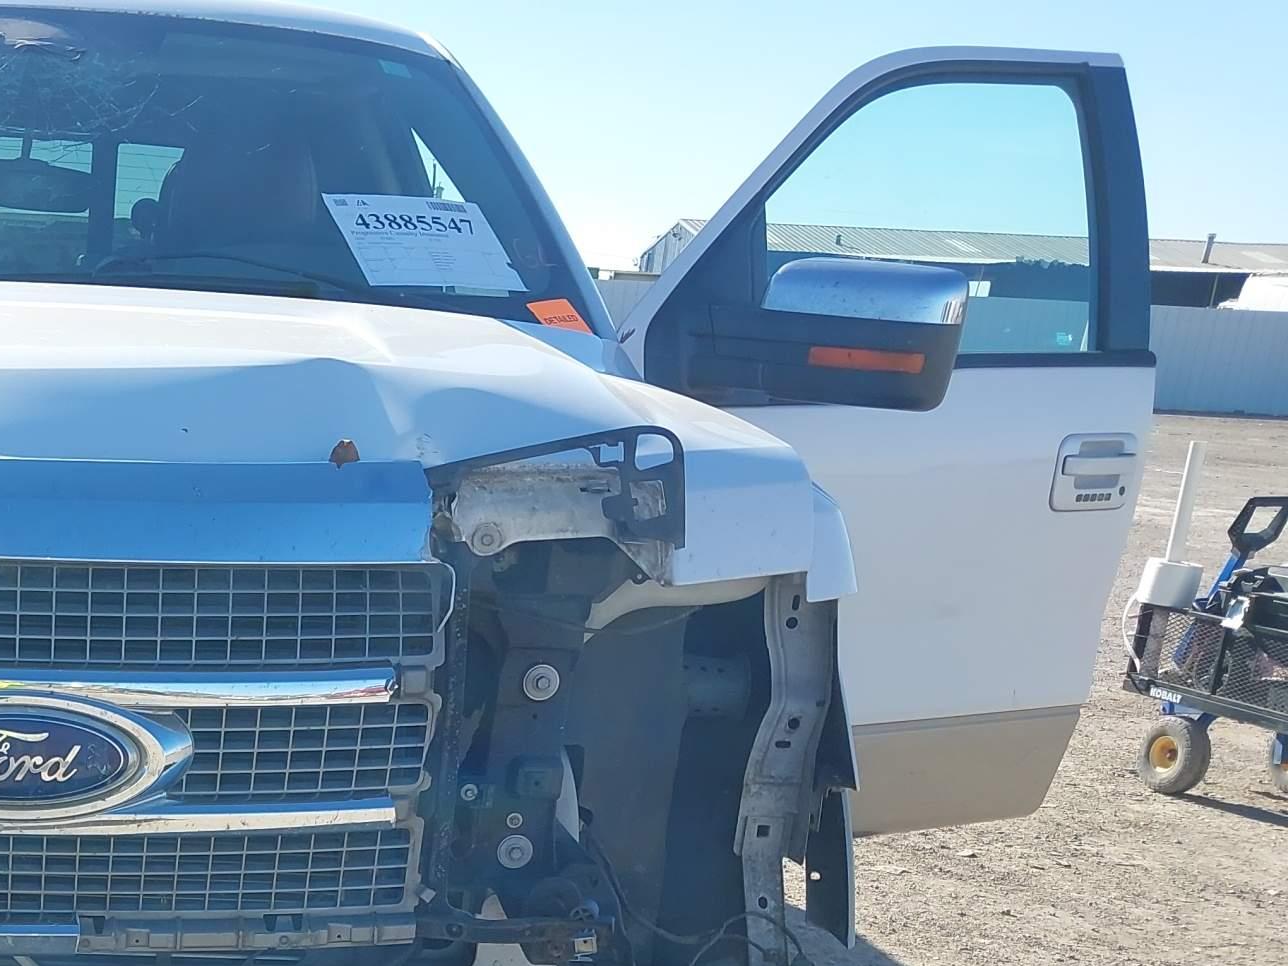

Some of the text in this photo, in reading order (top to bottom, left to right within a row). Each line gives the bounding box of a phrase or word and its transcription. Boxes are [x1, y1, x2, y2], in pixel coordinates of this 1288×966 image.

[355, 213, 474, 235] 43885547
[543, 314, 579, 325] DETAILED
[1149, 687, 1183, 704] KOBALT
